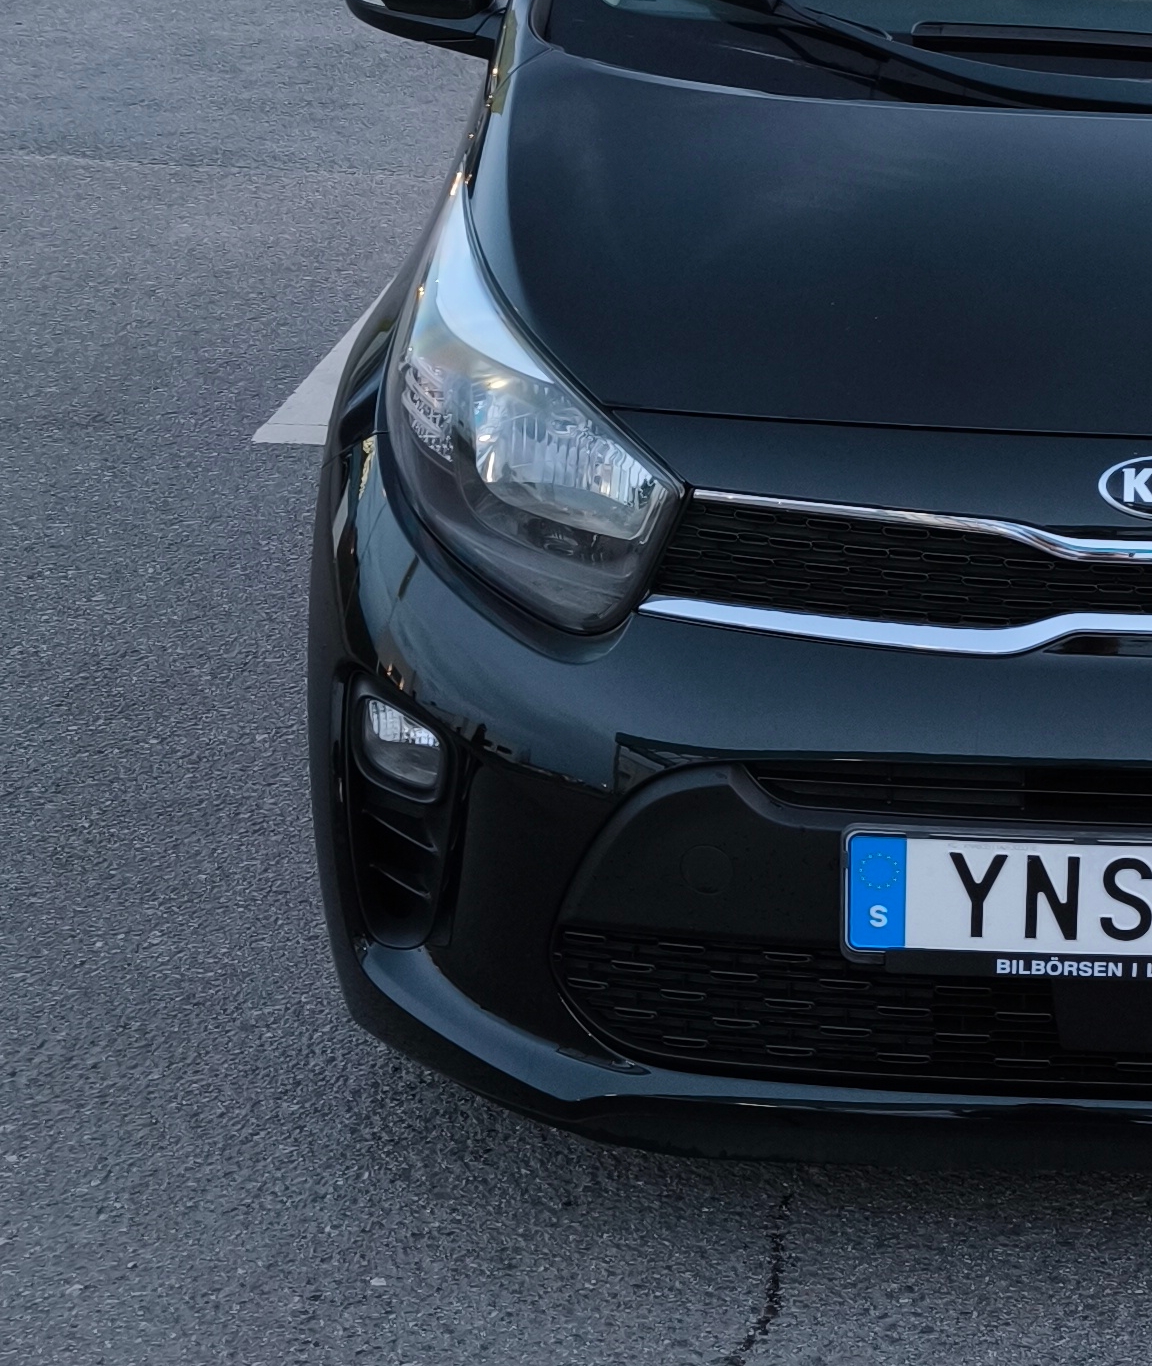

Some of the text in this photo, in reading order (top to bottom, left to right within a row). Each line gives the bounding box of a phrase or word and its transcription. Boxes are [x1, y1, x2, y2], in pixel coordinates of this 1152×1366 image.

[949, 852, 1152, 941] YNS
[869, 905, 888, 927] S
[996, 957, 1122, 977] BILBÖRSEN
[1131, 962, 1138, 977] I
